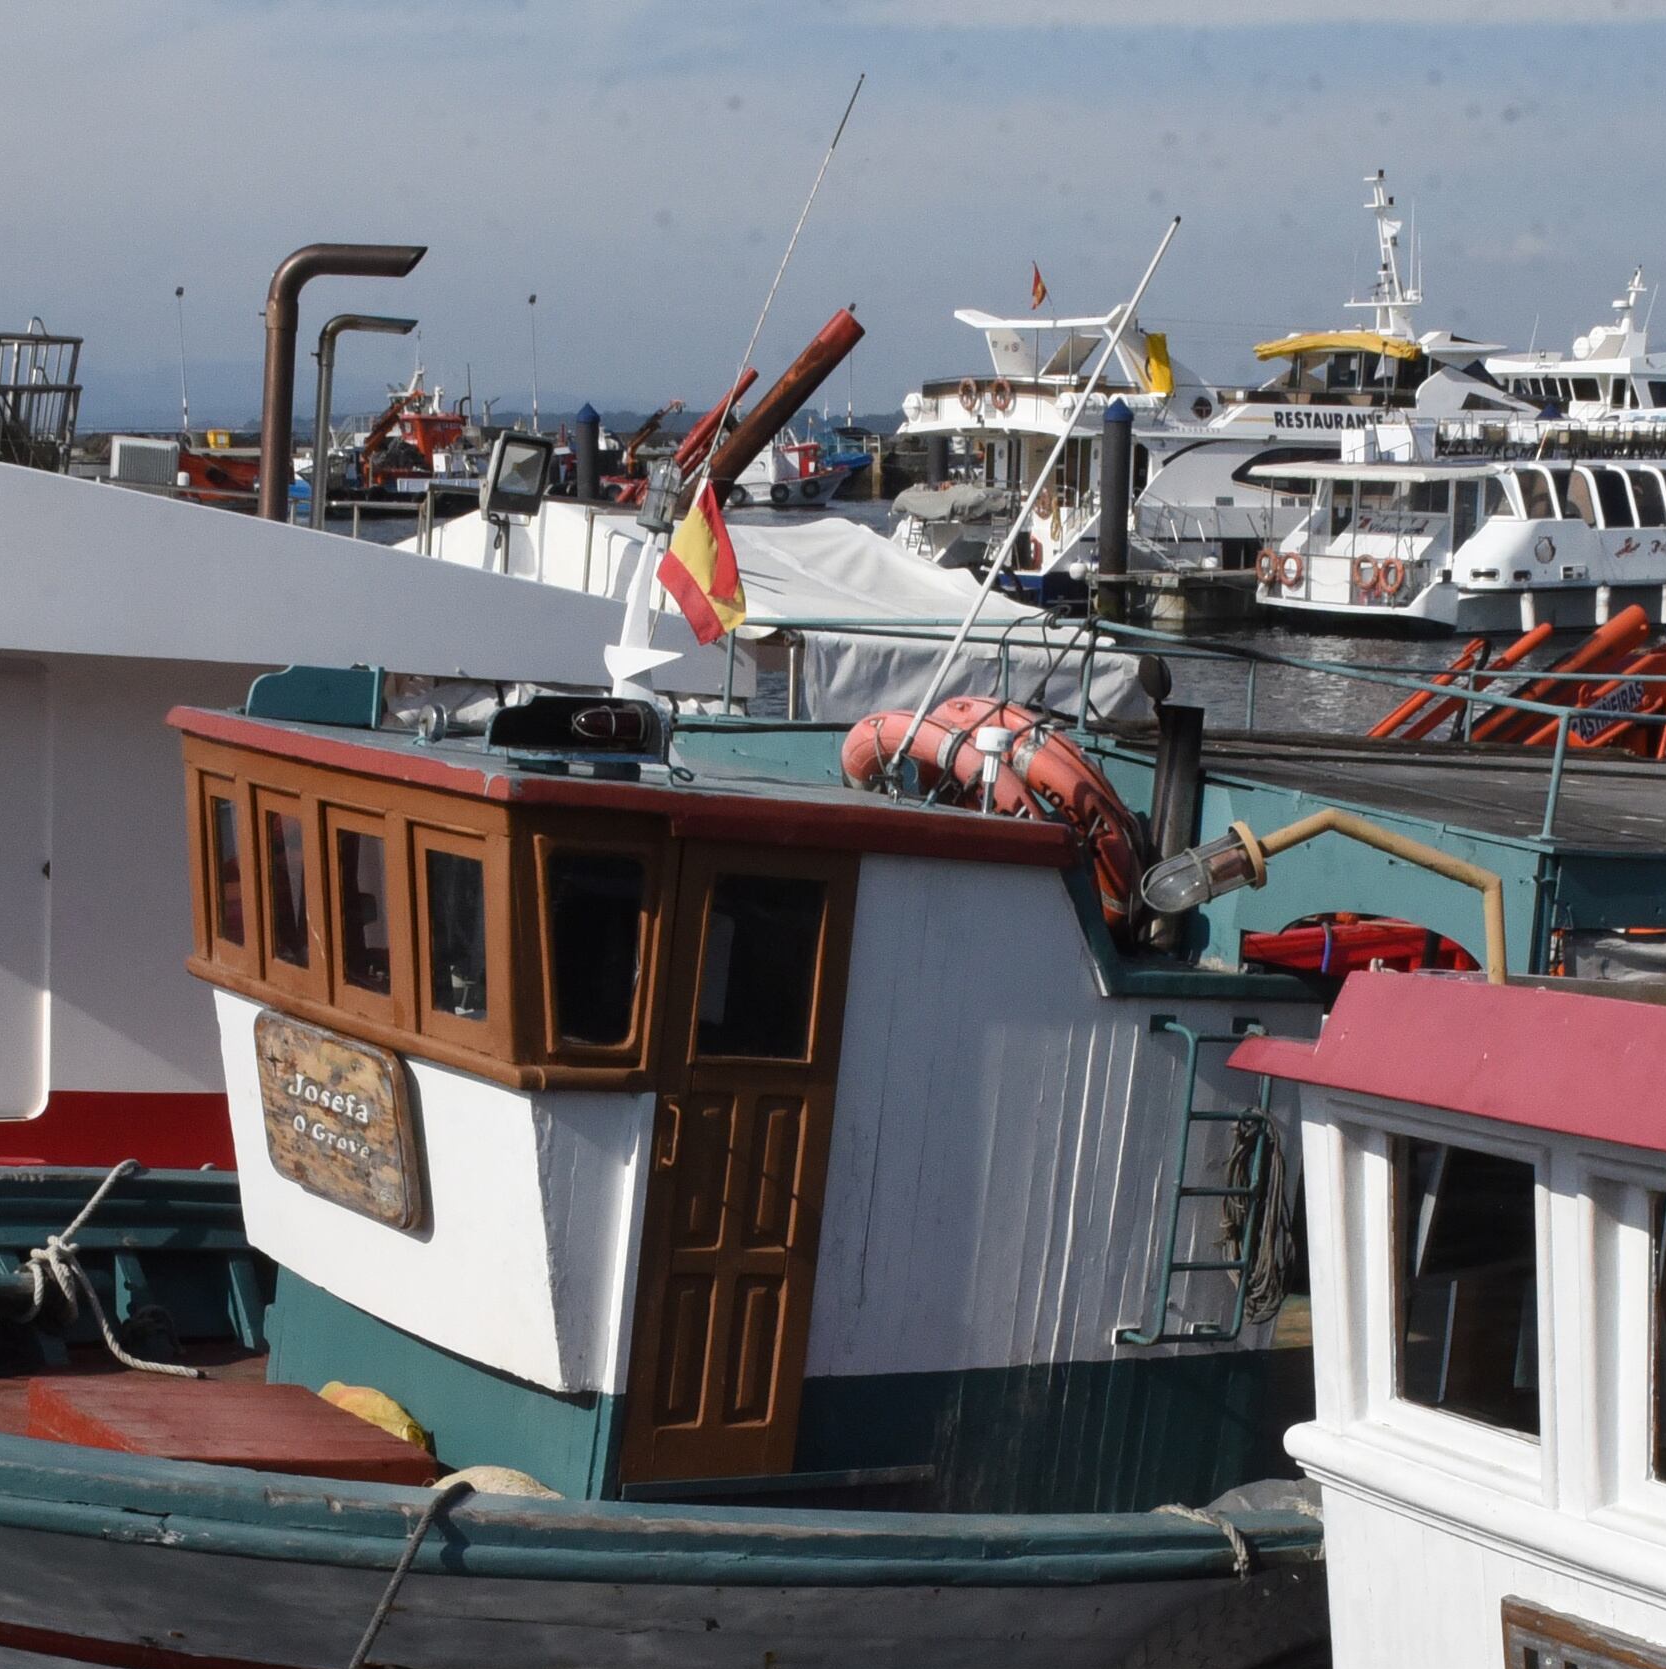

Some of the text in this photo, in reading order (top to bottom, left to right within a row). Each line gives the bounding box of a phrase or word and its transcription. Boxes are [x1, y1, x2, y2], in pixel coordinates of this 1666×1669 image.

[287, 1072, 369, 1125] Josefa
[292, 1114, 371, 1159] O Grove
